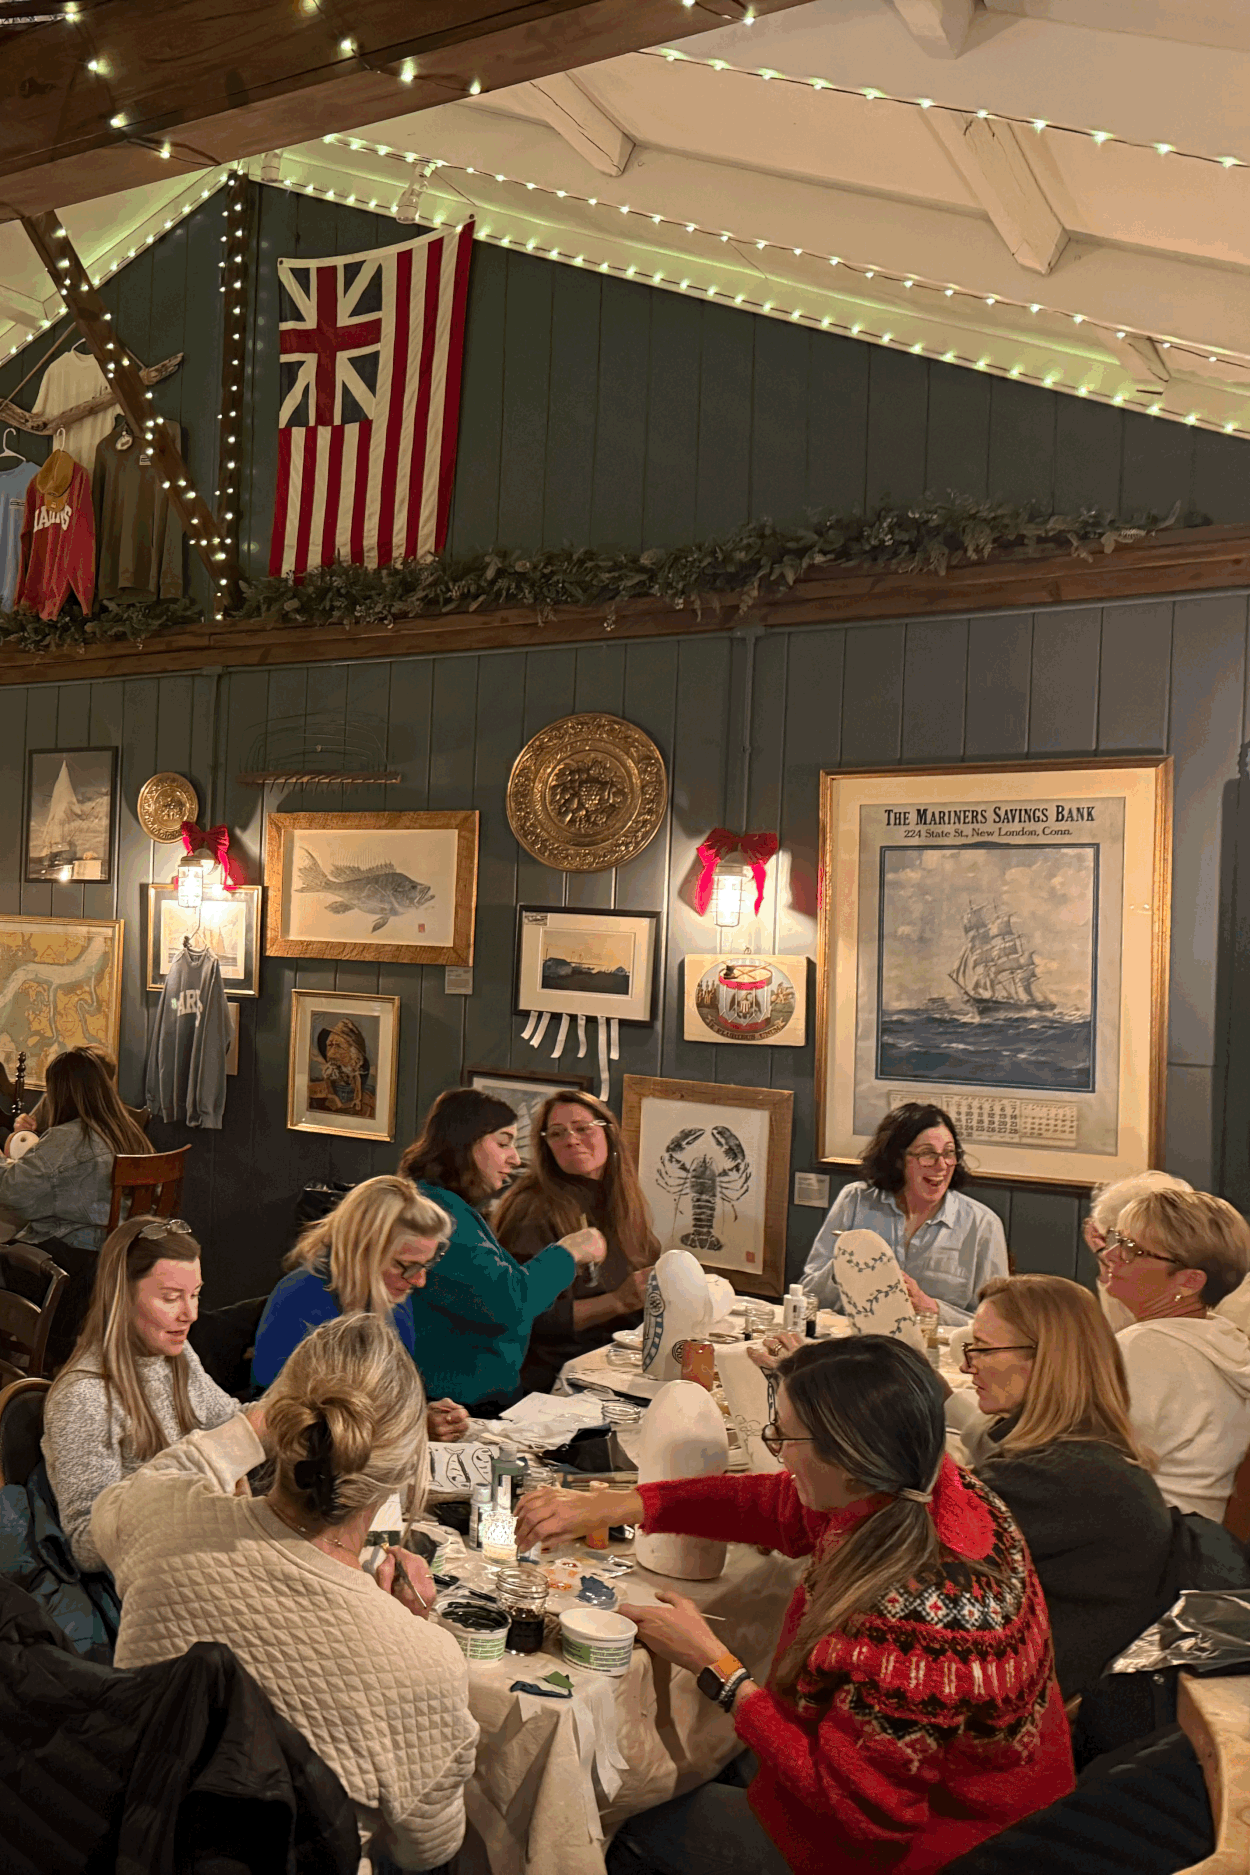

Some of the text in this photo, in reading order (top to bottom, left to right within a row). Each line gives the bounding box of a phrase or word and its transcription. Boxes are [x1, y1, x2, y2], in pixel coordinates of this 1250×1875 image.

[885, 804, 1096, 826] THE MARINERS SAVINGS BANK
[903, 829, 922, 838] 224
[924, 829, 950, 838] State
[971, 828, 995, 837] New
[998, 827, 1040, 837] London,
[1042, 826, 1073, 836] Conn.
